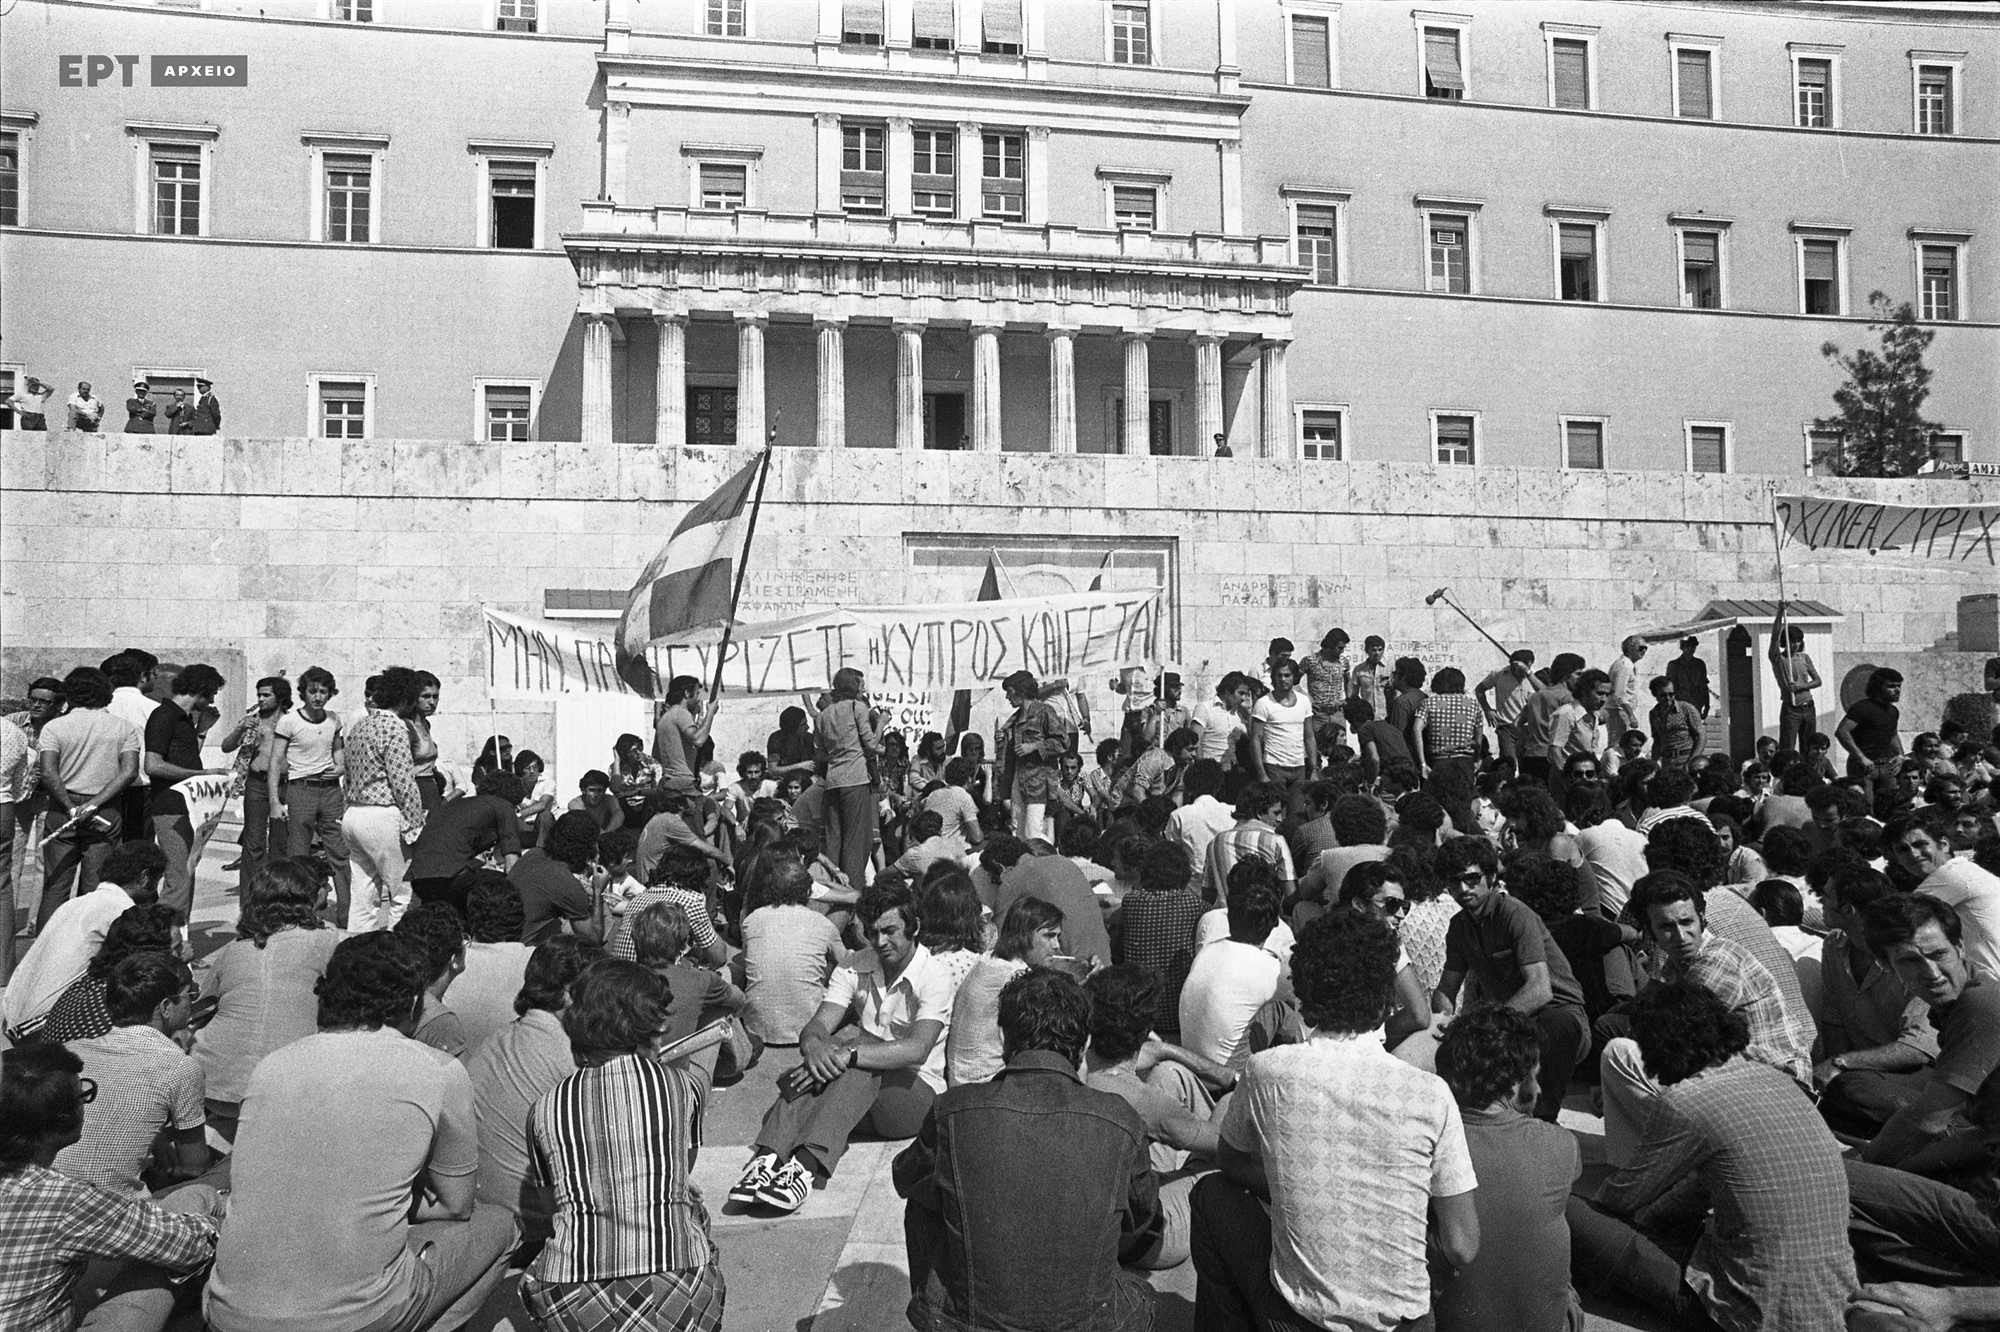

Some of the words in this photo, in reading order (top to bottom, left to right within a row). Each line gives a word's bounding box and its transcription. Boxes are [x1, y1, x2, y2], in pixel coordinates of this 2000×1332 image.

[575, 622, 857, 695] ΠΑΓΥΡΙΖΕΤΕ
[881, 617, 1010, 688] ΚΥΠΡΟΣ
[1021, 597, 1159, 677] ΚΑΙΓΕΤΑΙ
